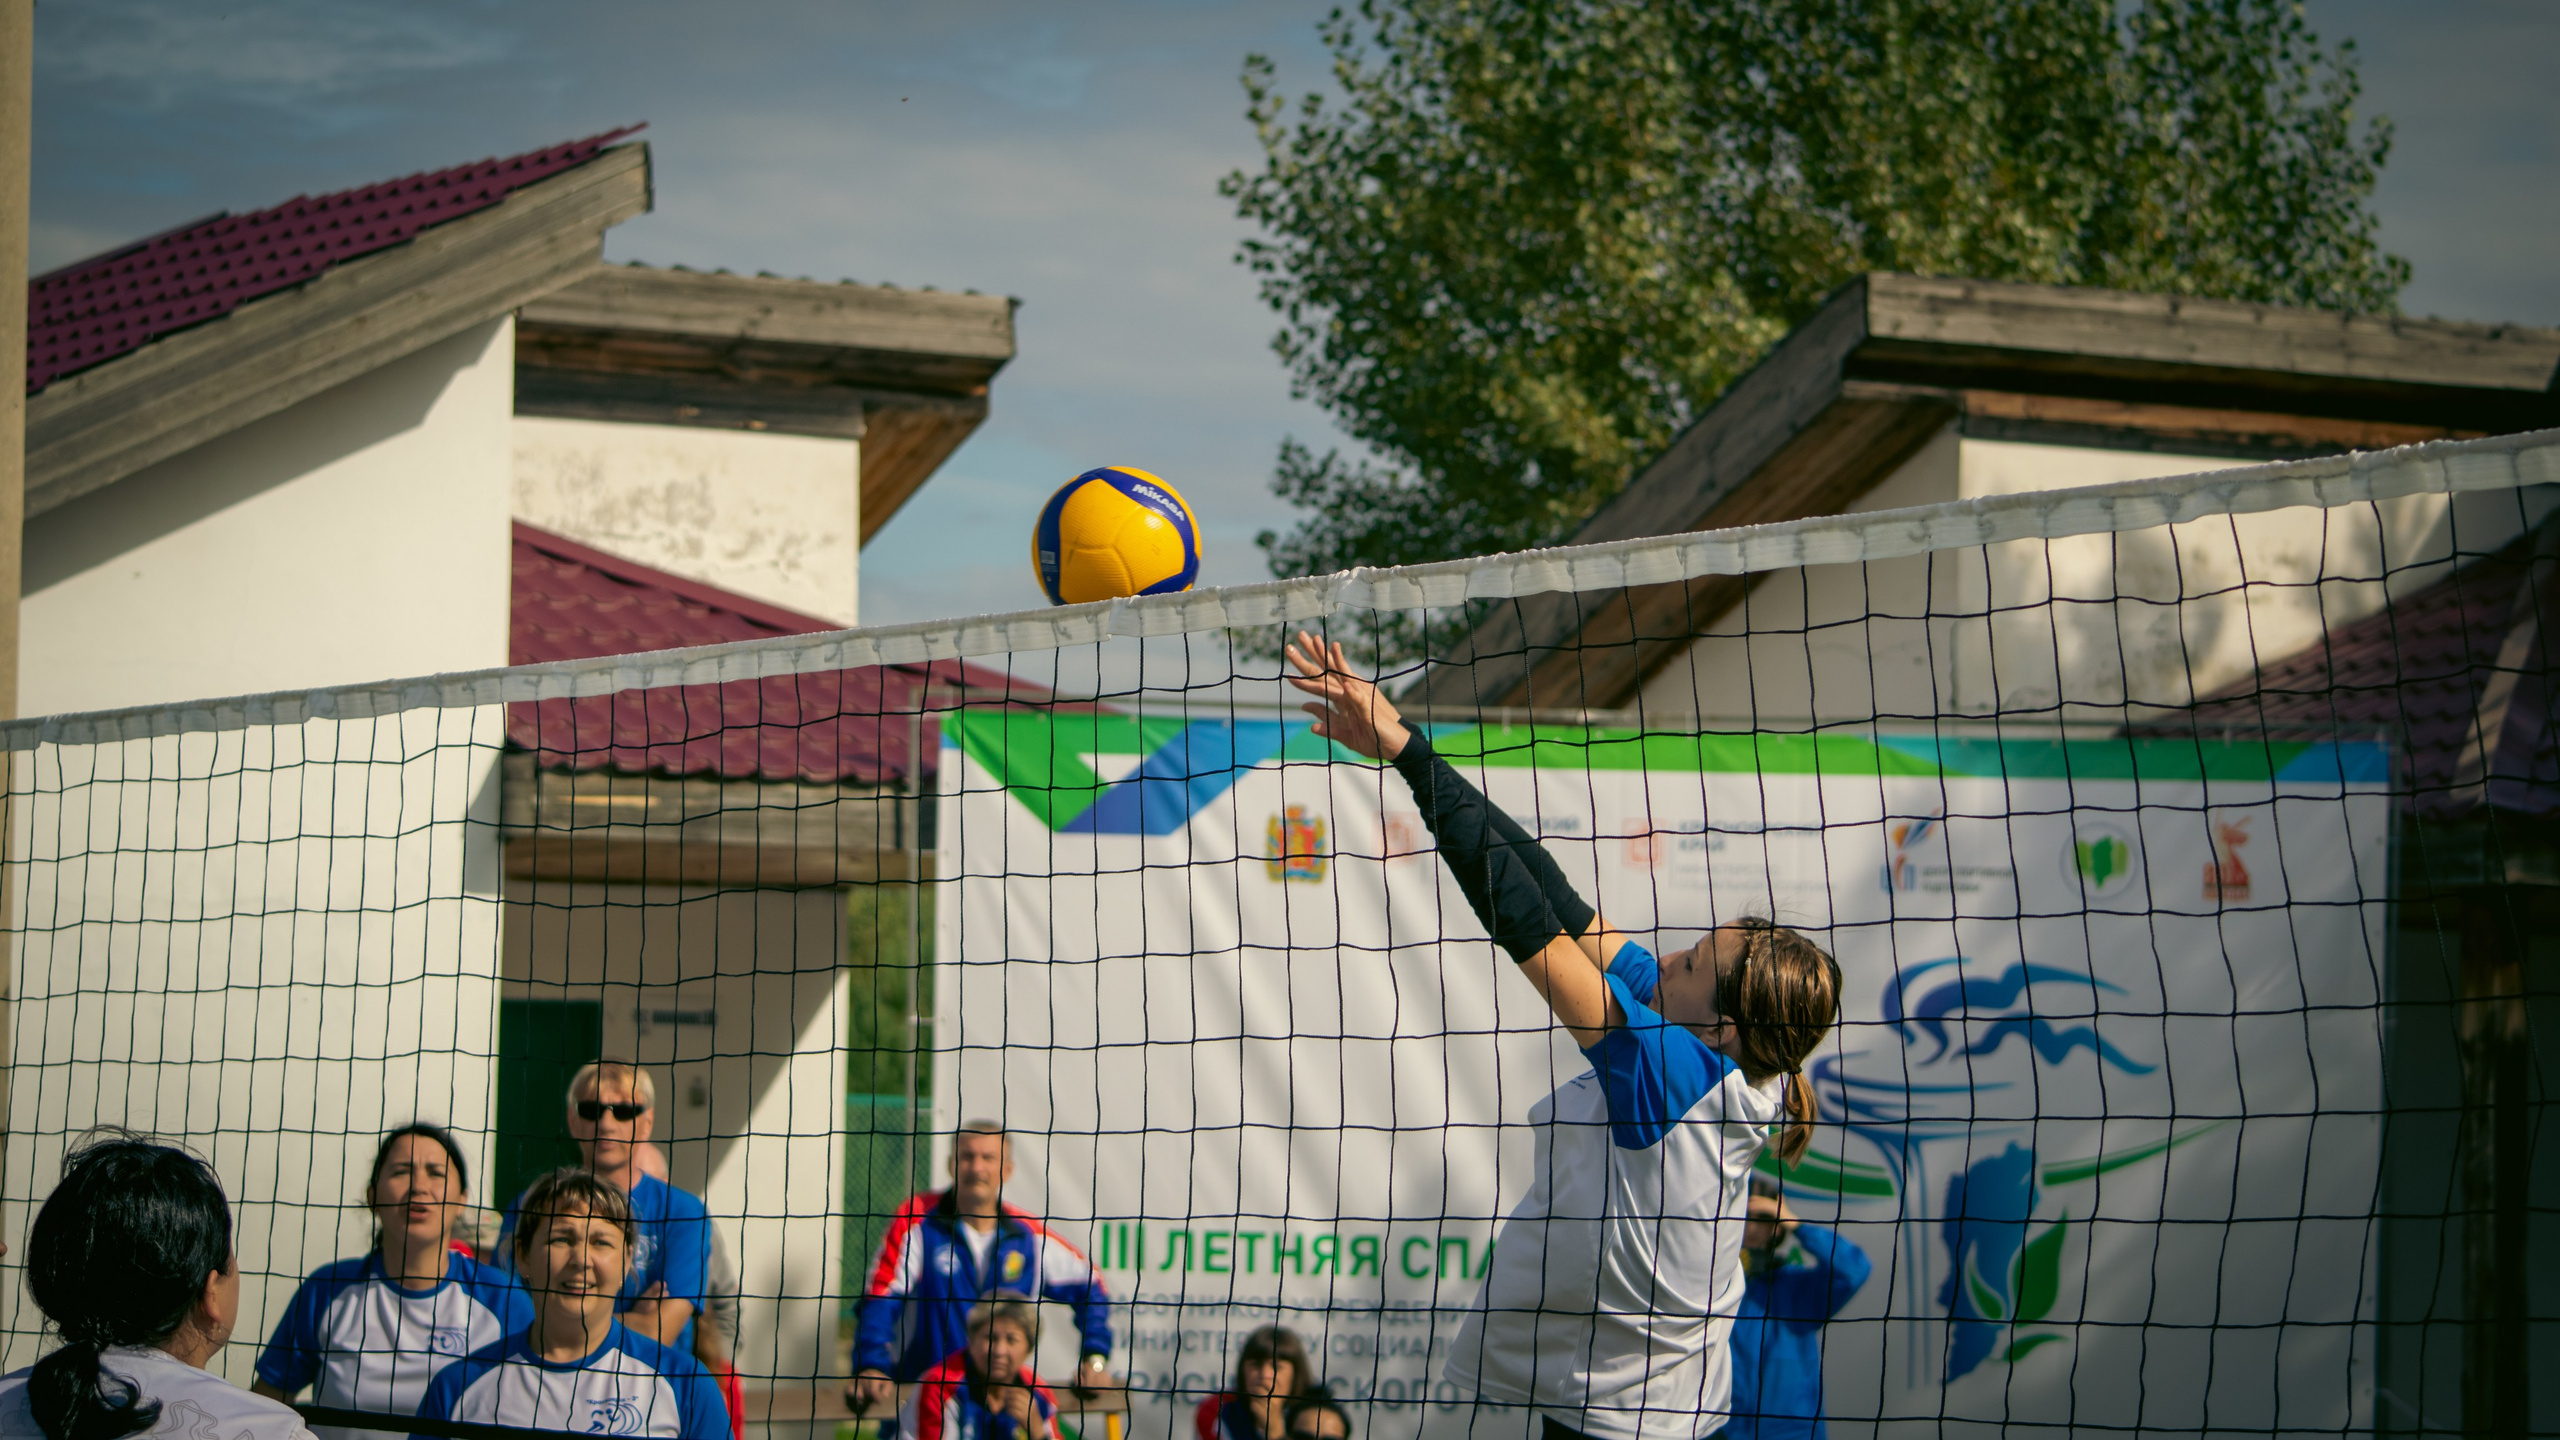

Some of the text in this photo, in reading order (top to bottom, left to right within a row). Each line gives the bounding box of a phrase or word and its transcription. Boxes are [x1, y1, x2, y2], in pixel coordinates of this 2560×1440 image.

[1159, 1229, 1379, 1277] ЛЕТНЯЯ
[1110, 1293, 1471, 1326] АБОТНИКОВ УЧРЕЖДЕНИ
[1330, 1333, 1455, 1361] СОЦИАЛ
